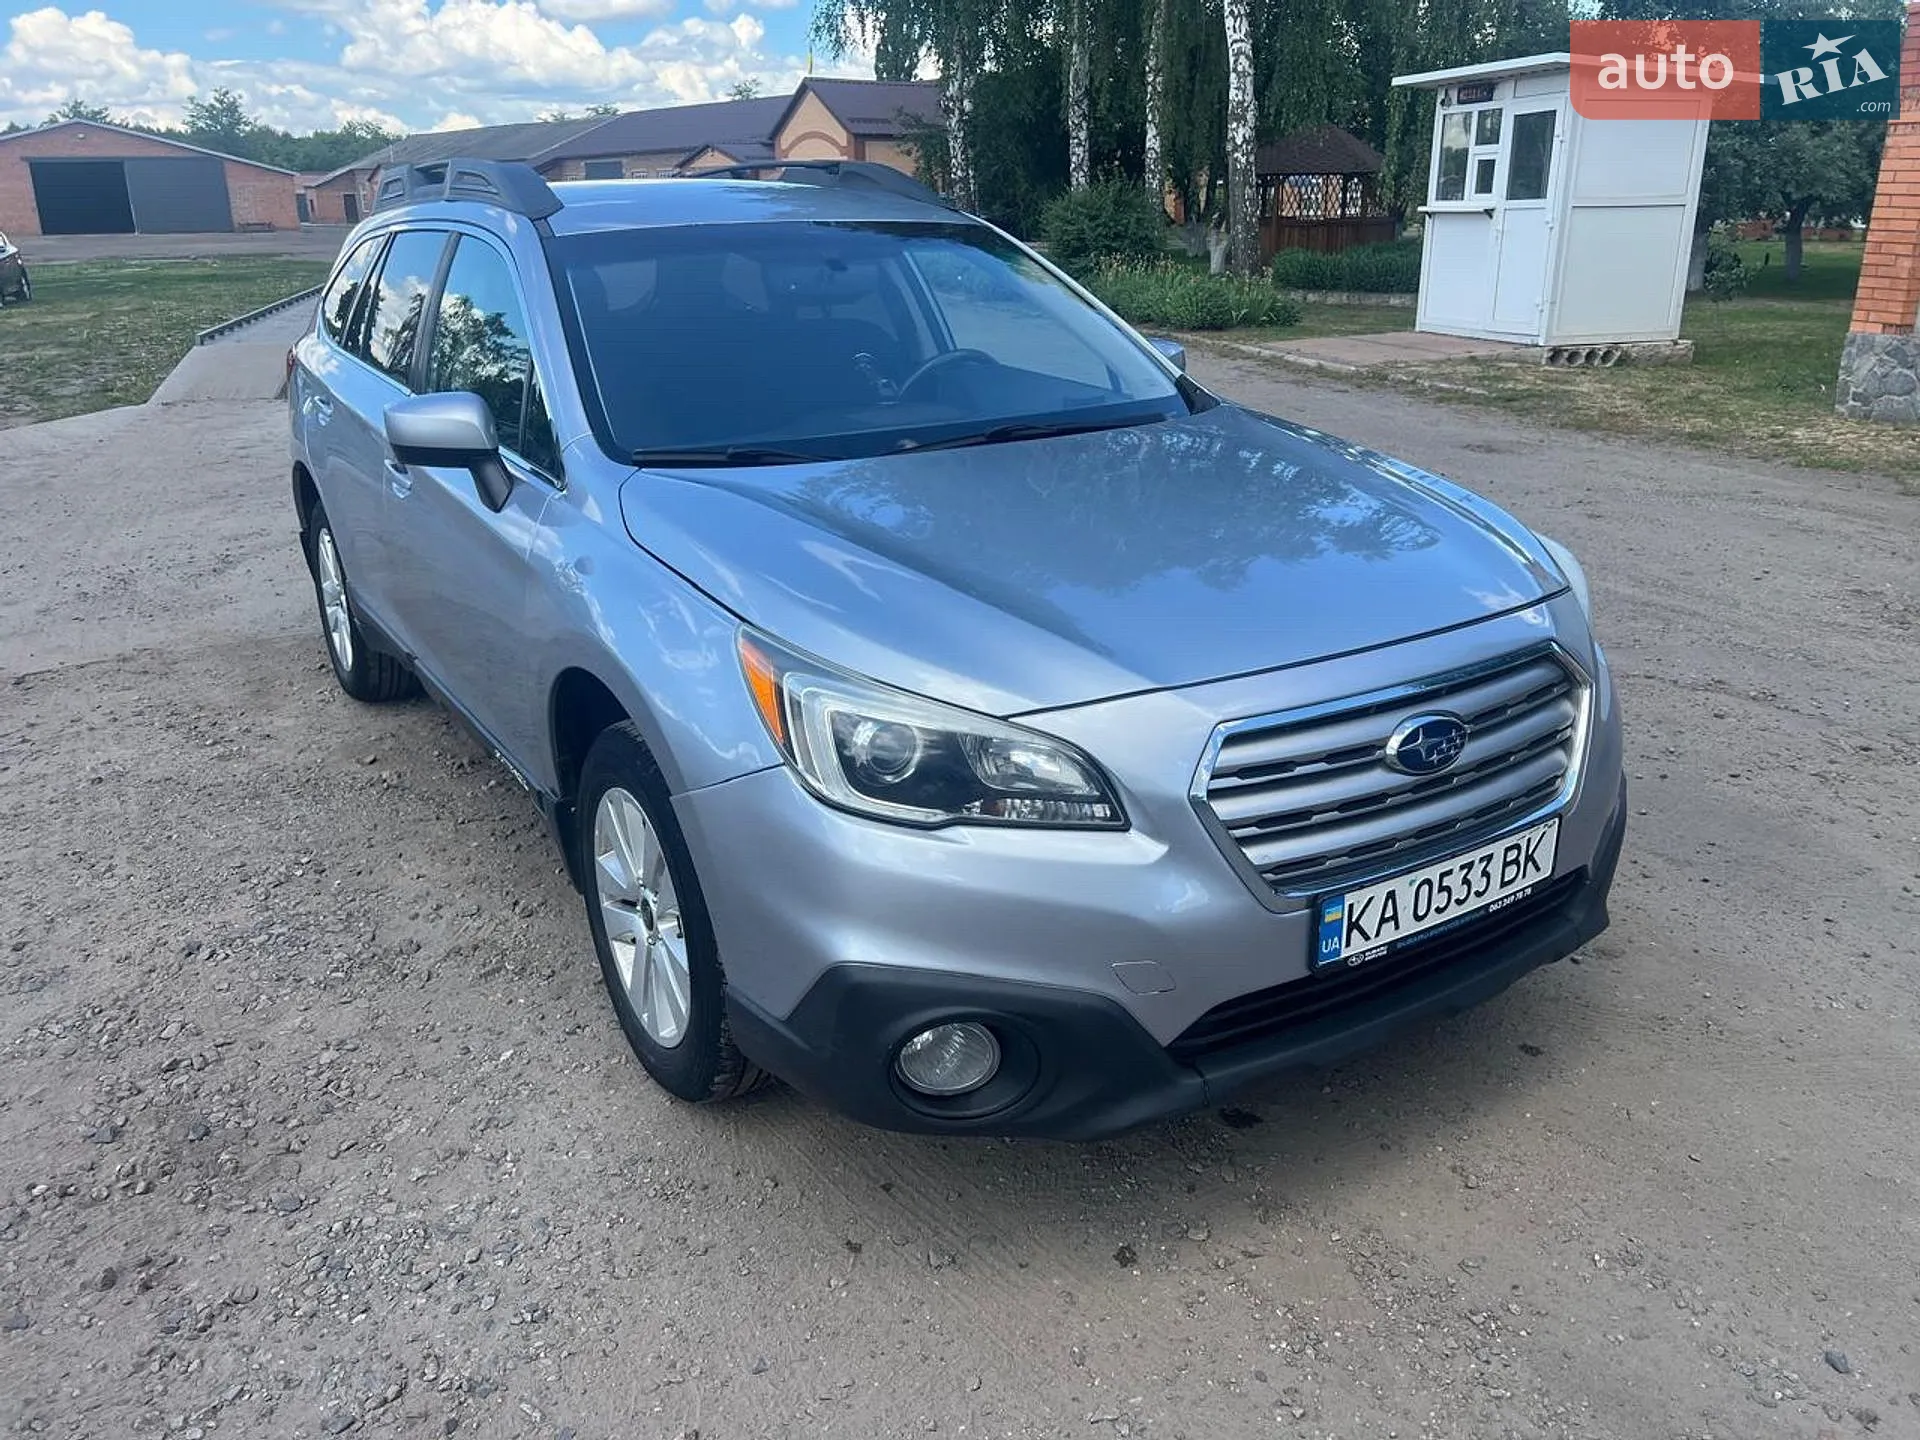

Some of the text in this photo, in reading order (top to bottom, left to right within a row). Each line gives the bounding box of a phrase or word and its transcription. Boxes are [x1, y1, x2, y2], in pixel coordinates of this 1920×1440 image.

[1345, 889, 1400, 948] KA
[1412, 852, 1494, 922] 0533
[1500, 832, 1546, 890] BK
[1321, 937, 1340, 953] UA
